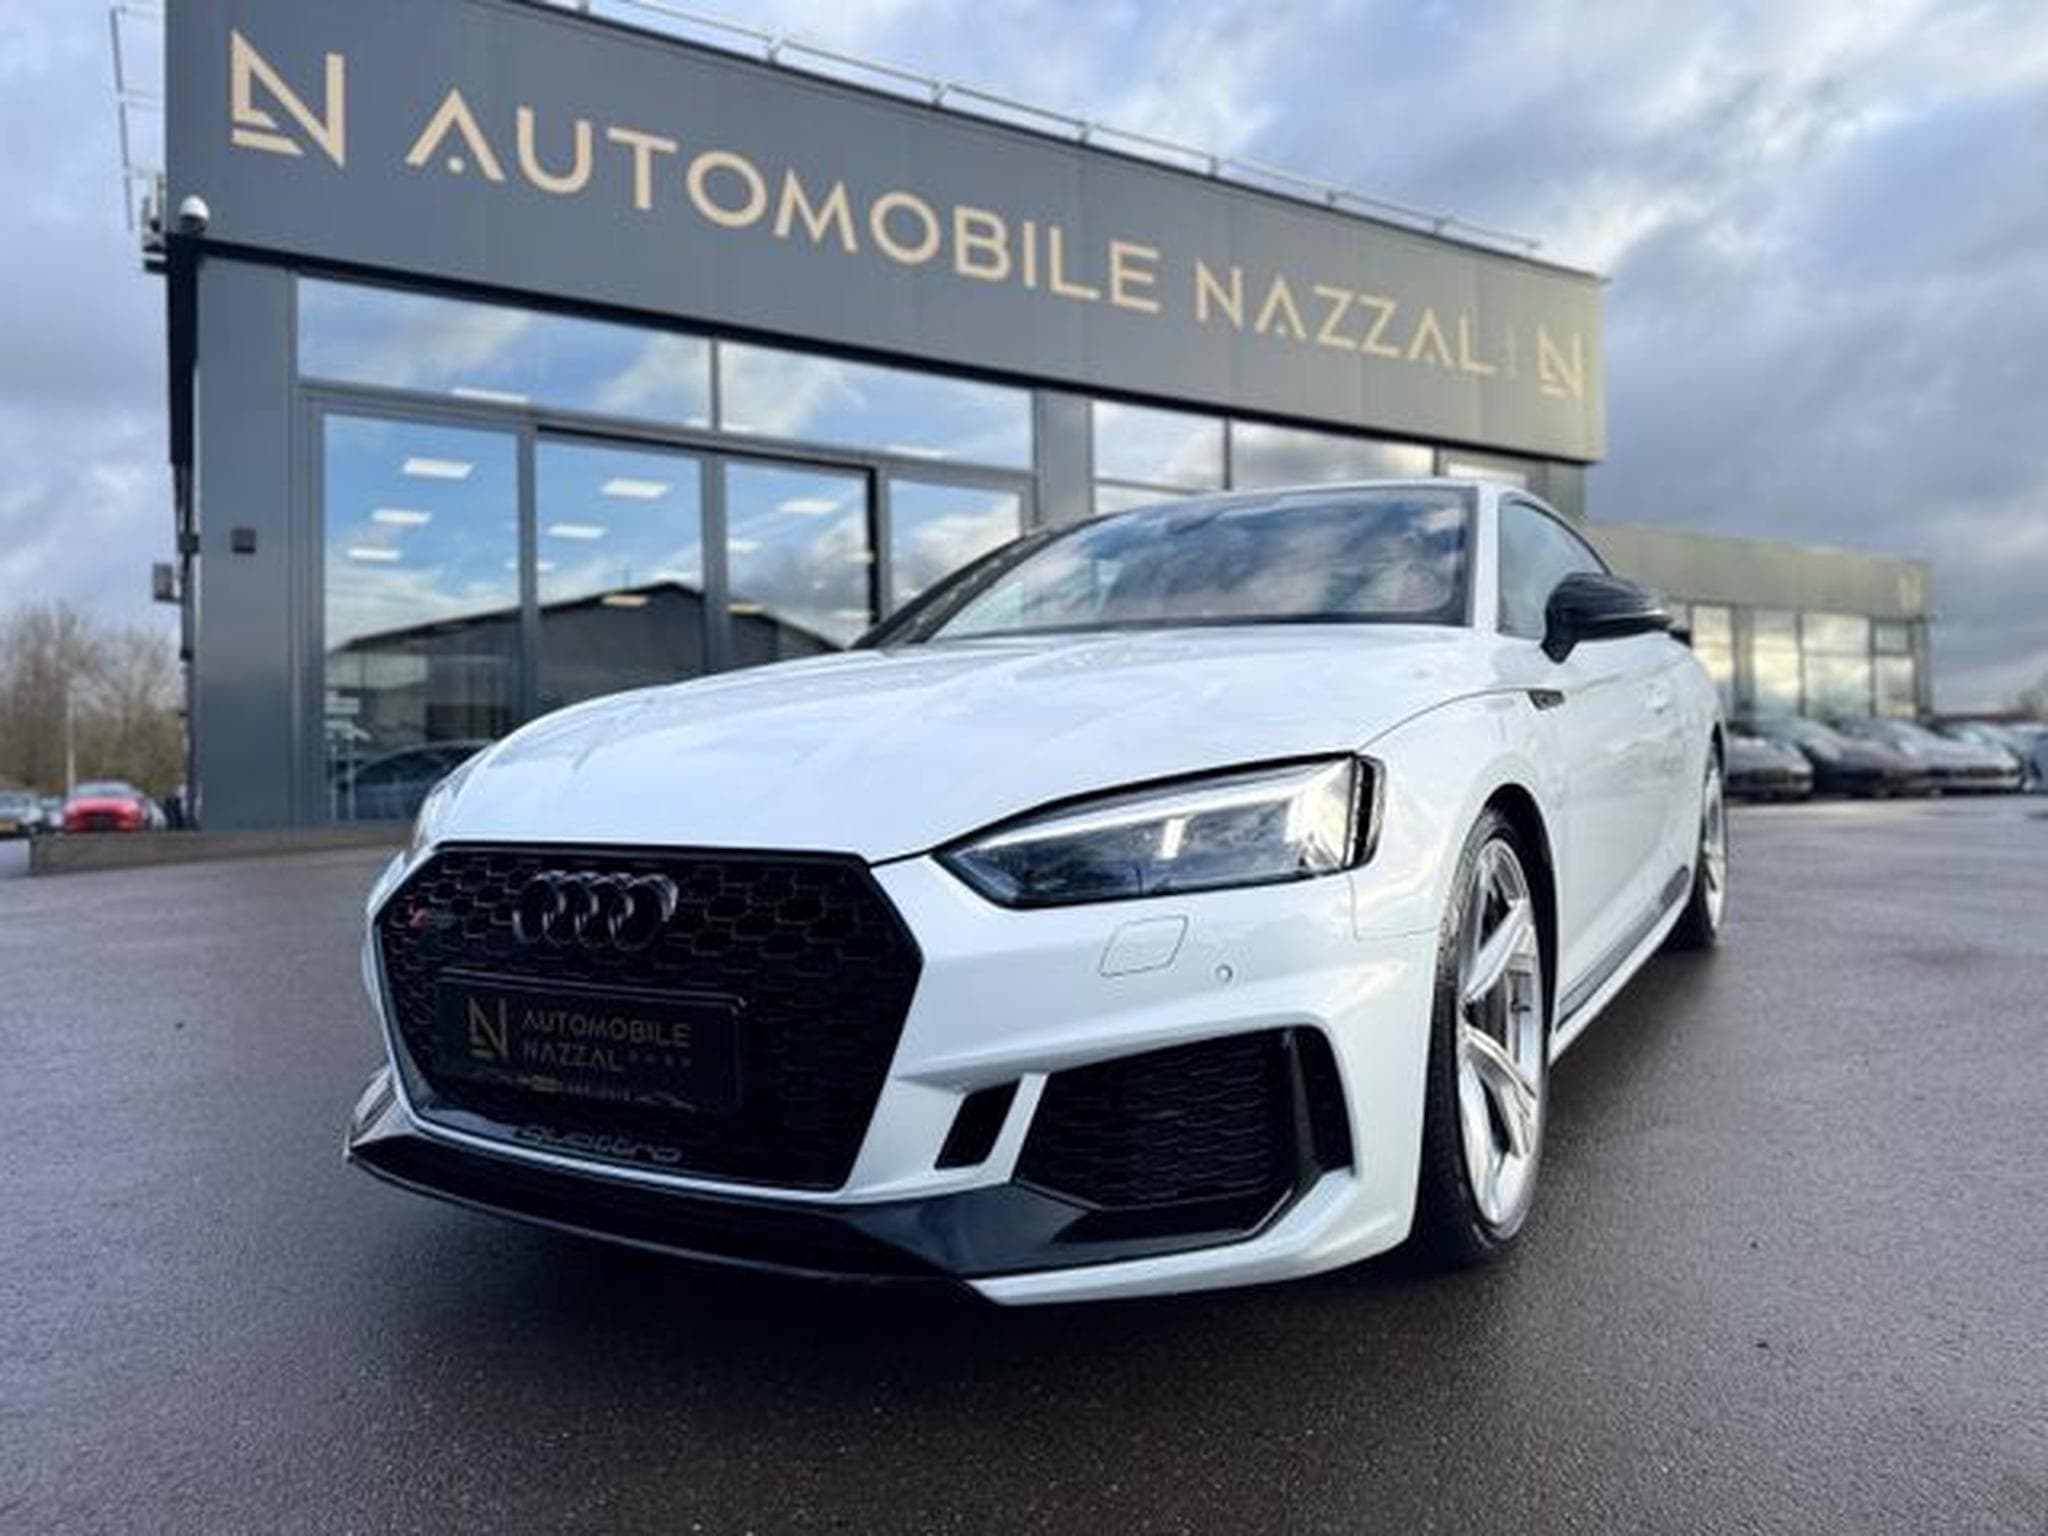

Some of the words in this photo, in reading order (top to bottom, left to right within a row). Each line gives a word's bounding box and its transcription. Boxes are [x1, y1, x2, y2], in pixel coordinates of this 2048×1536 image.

[405, 88, 1160, 312] AUTOMOBILE
[1195, 261, 1496, 375] NAZZAL
[521, 1009, 692, 1048] AUTOMOBILE
[522, 1039, 626, 1073] NAZZAL
